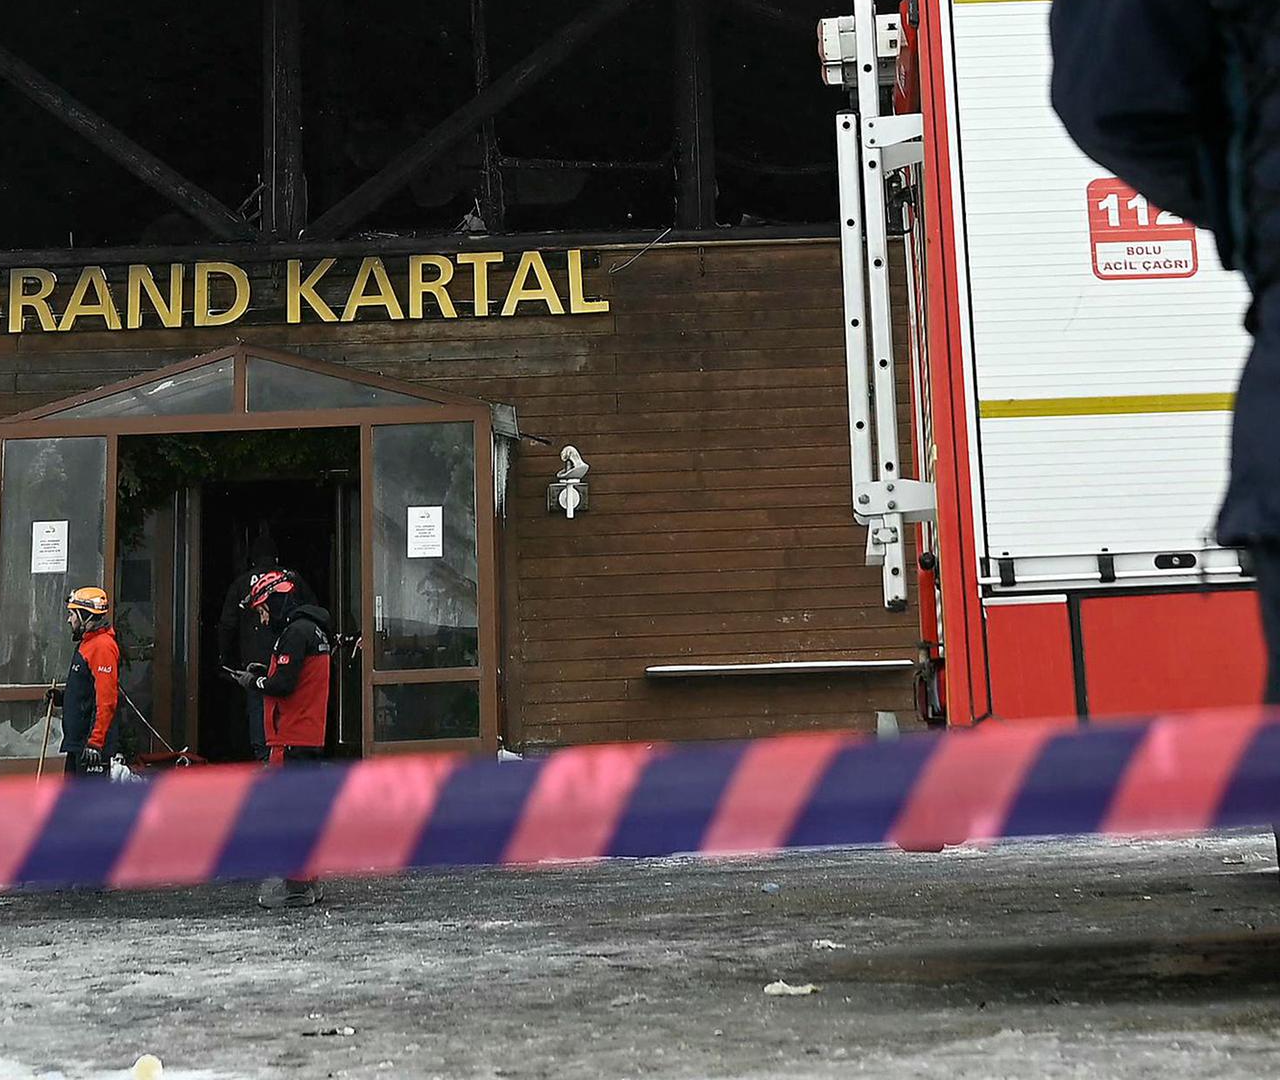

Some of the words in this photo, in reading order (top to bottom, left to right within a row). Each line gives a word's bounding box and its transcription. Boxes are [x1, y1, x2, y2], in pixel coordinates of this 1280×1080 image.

[1126, 246, 1162, 256] BOLU
[1103, 260, 1137, 271] ACİL
[1142, 259, 1189, 272] ÇAĞRI
[286, 248, 610, 323] KARTAL
